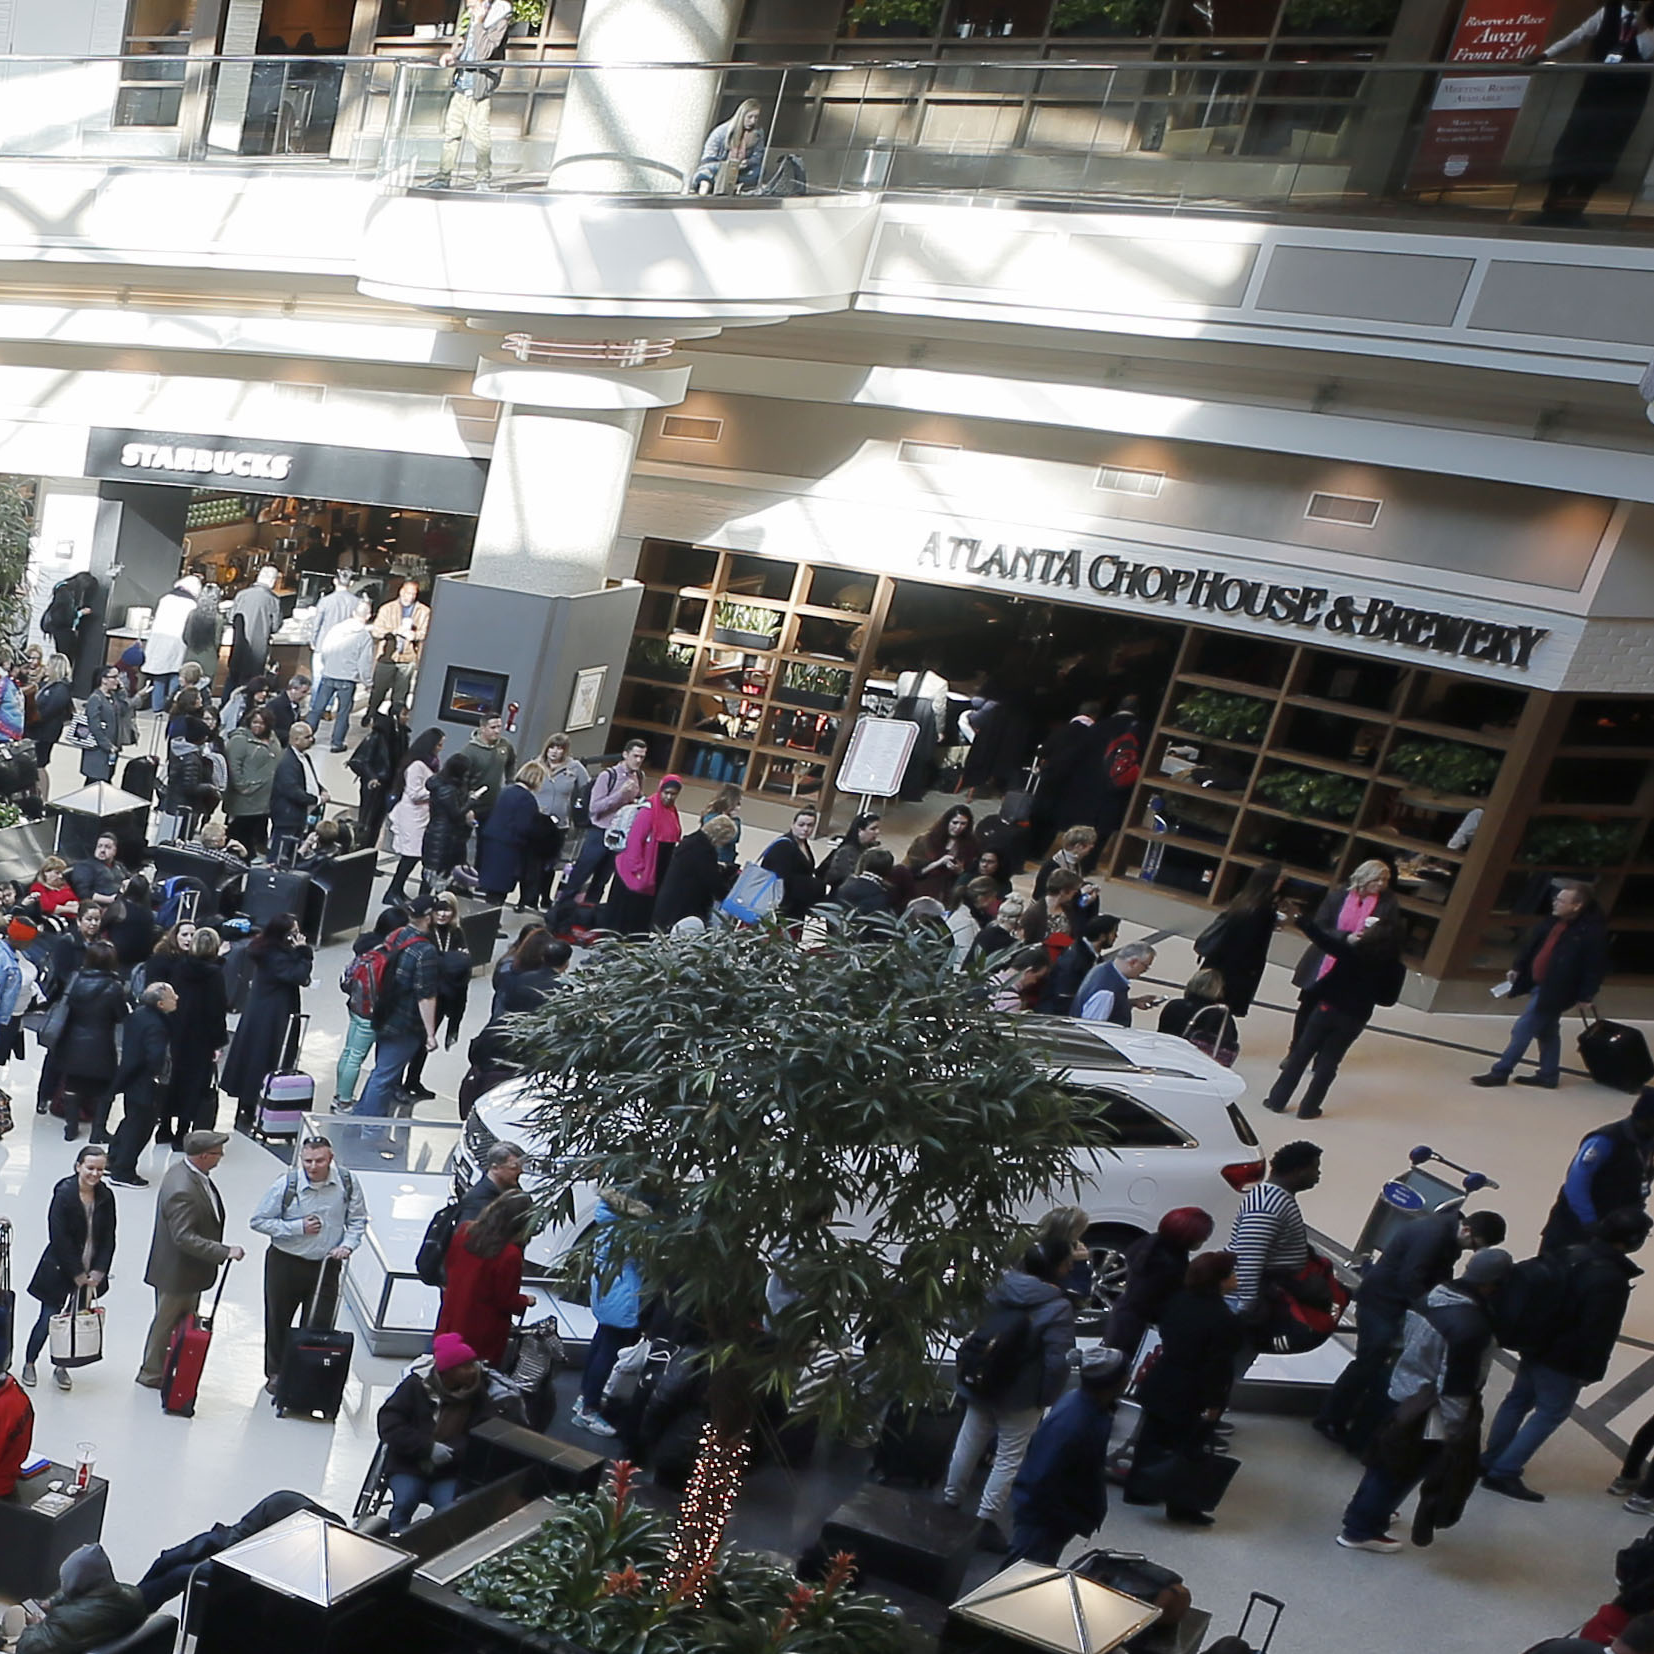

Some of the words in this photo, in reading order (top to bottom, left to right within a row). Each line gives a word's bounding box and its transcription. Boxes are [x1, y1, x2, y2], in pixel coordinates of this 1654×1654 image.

[1465, 16, 1505, 27] Reserve
[1516, 14, 1546, 25] Place
[1473, 27, 1528, 46] Away
[1454, 48, 1493, 61] From
[1496, 46, 1509, 59] it
[121, 443, 292, 480] STARBUCKS
[917, 531, 1082, 588] ATLANTA
[1088, 554, 1329, 628] CHOPHOUSE
[1325, 595, 1360, 636] &
[1358, 598, 1551, 670] BREWERY
